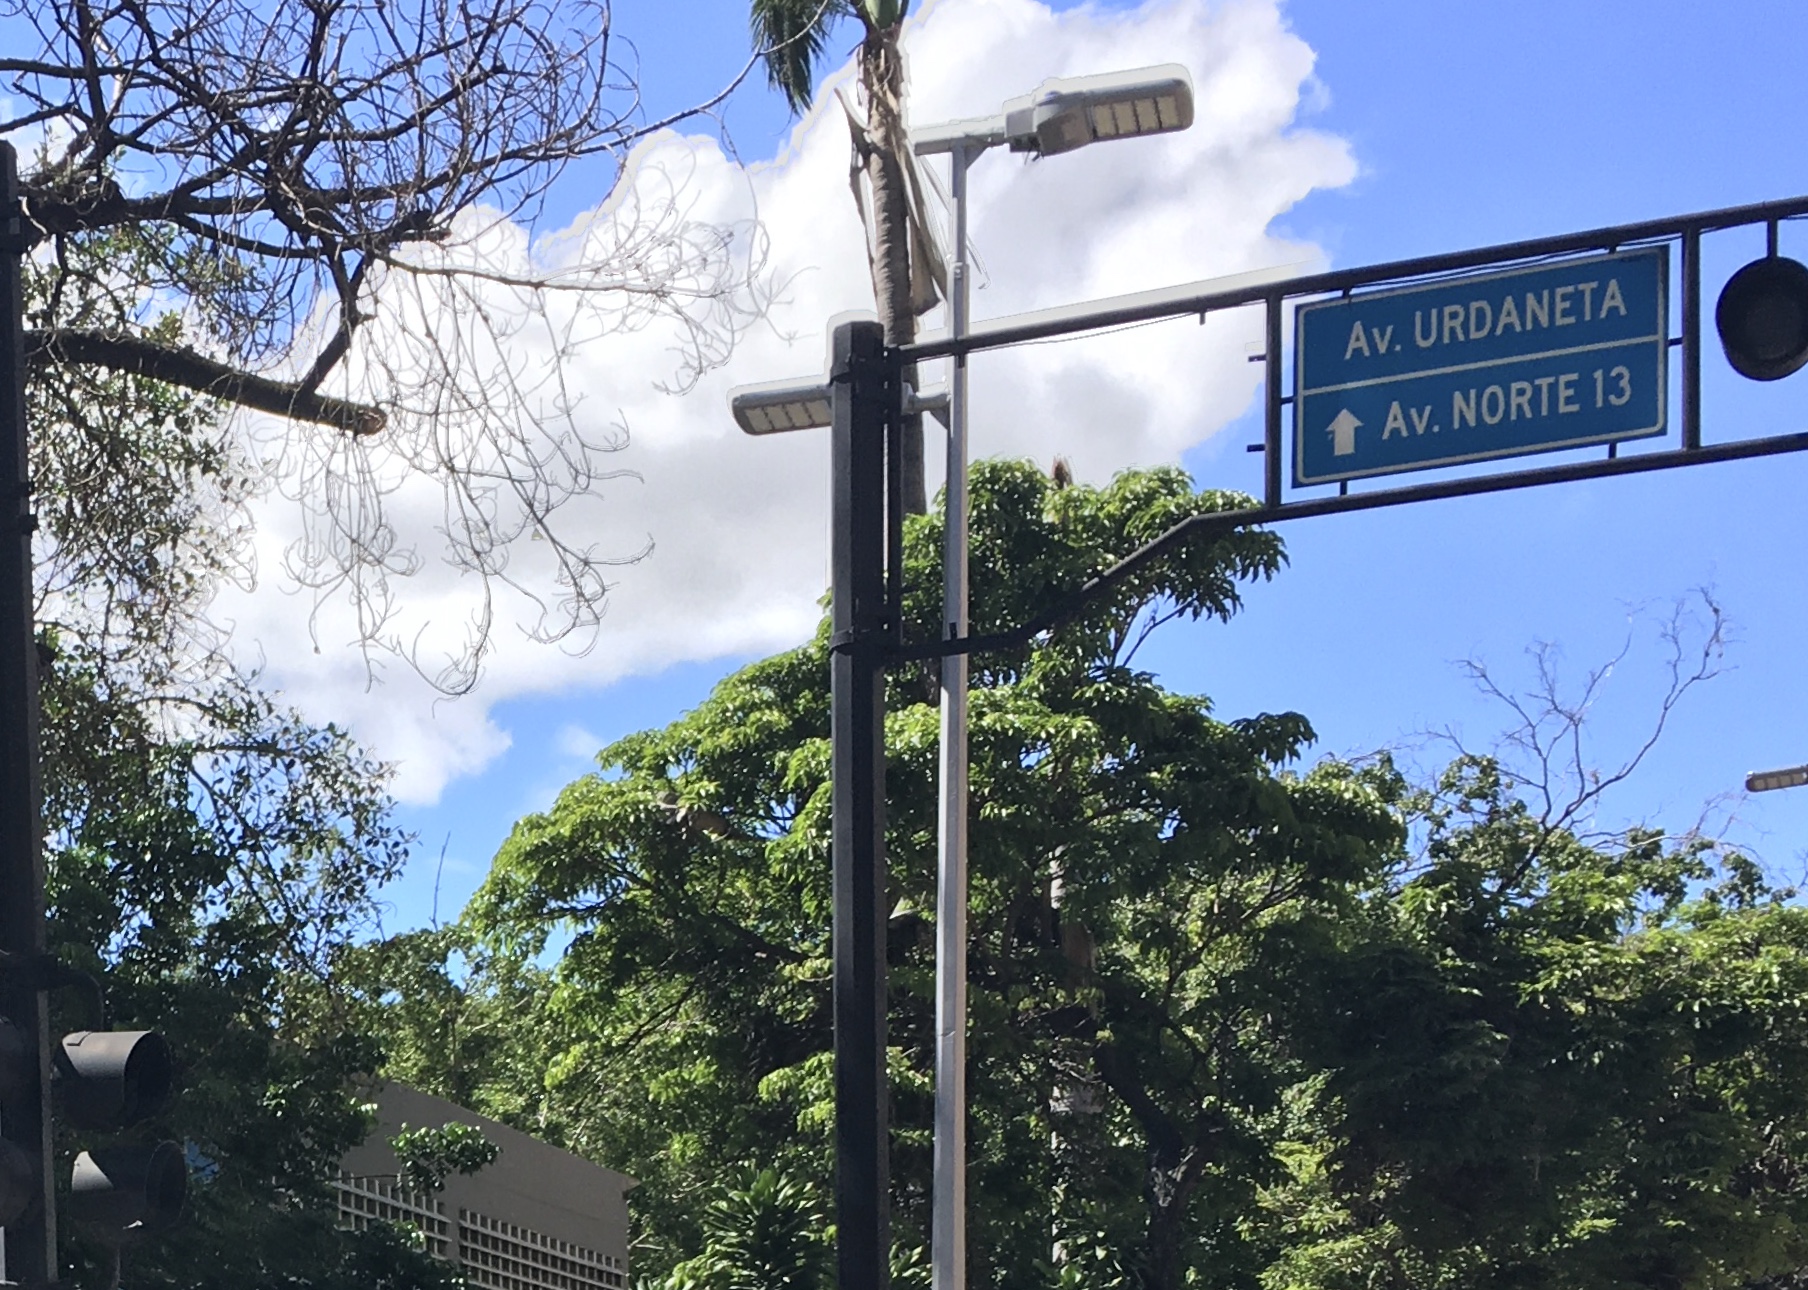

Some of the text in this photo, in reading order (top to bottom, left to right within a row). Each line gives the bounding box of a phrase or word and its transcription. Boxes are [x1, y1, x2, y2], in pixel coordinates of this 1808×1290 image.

[1414, 279, 1628, 349] URDANETA
[1453, 372, 1581, 430] NORTE
[1593, 365, 1632, 409] 13
